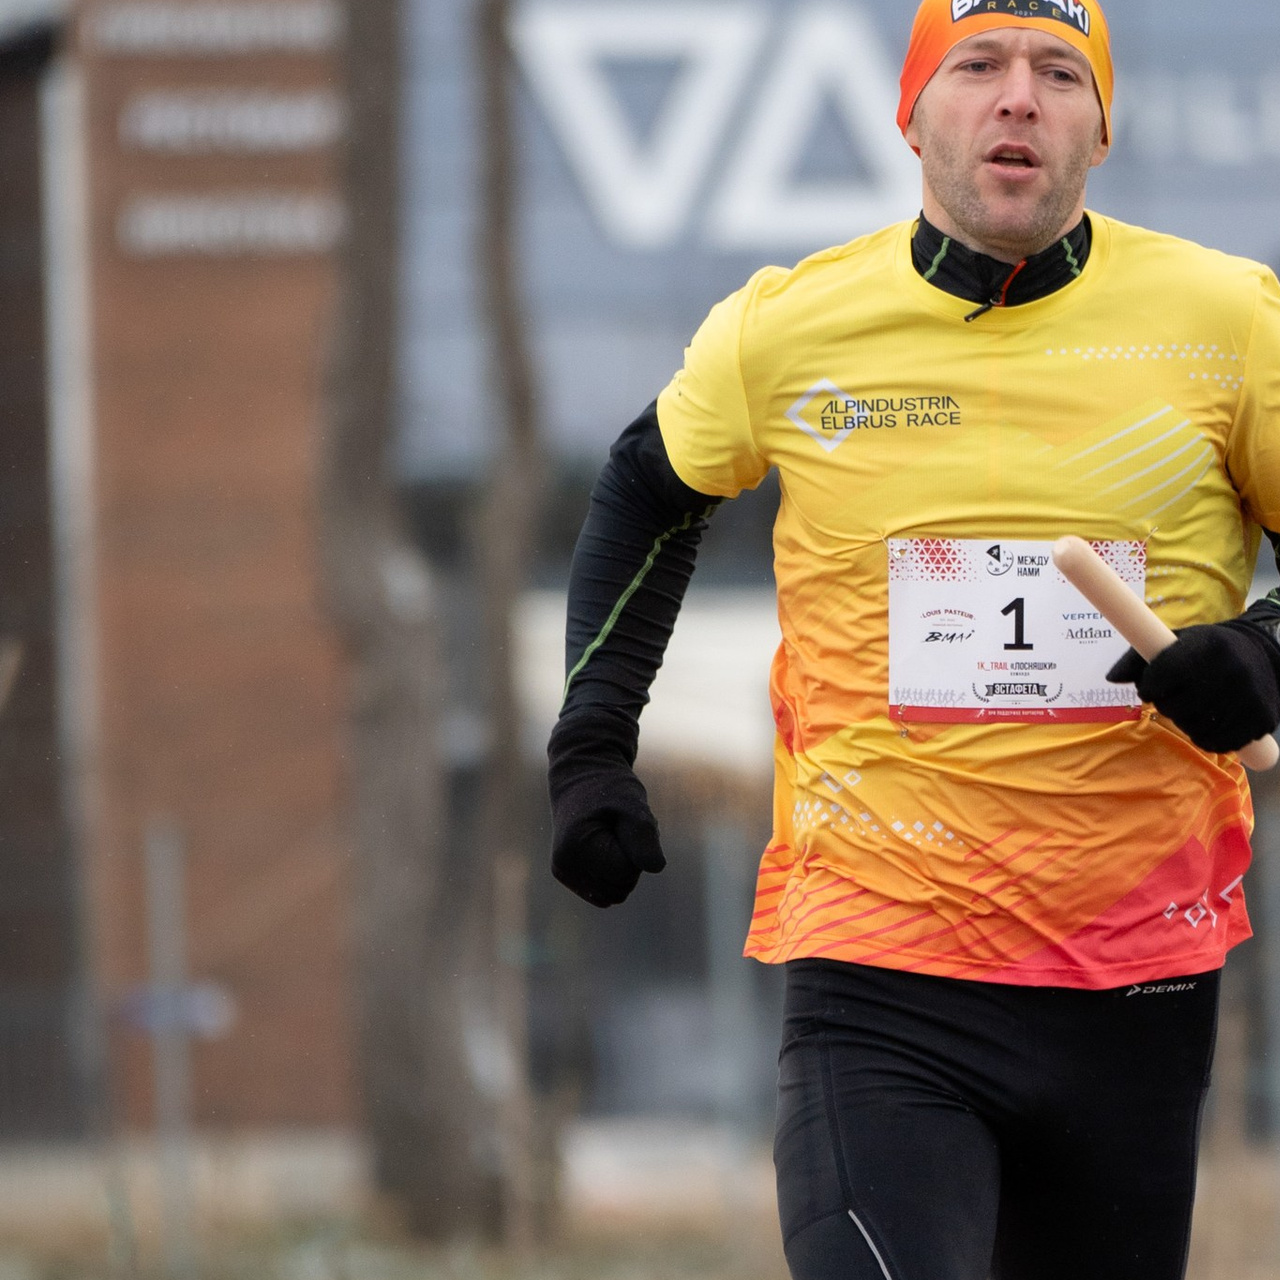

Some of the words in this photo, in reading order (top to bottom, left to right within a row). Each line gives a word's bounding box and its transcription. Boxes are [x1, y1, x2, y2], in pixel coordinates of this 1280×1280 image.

[987, 0, 1062, 18] RACE
[821, 396, 960, 415] ALPINDUSTRIA
[821, 414, 897, 430] ELBRUS
[906, 411, 961, 427] RACE
[1017, 555, 1050, 567] МЕЖДУ
[1017, 567, 1040, 577] НАМИ
[922, 609, 942, 619] LOUIS
[944, 608, 974, 620] PASTEUR
[1000, 597, 1034, 651] 1
[1065, 627, 1112, 639] Adrian
[994, 683, 1038, 695] ЭСТАФЕТА
[1142, 981, 1197, 995] DEMIX
